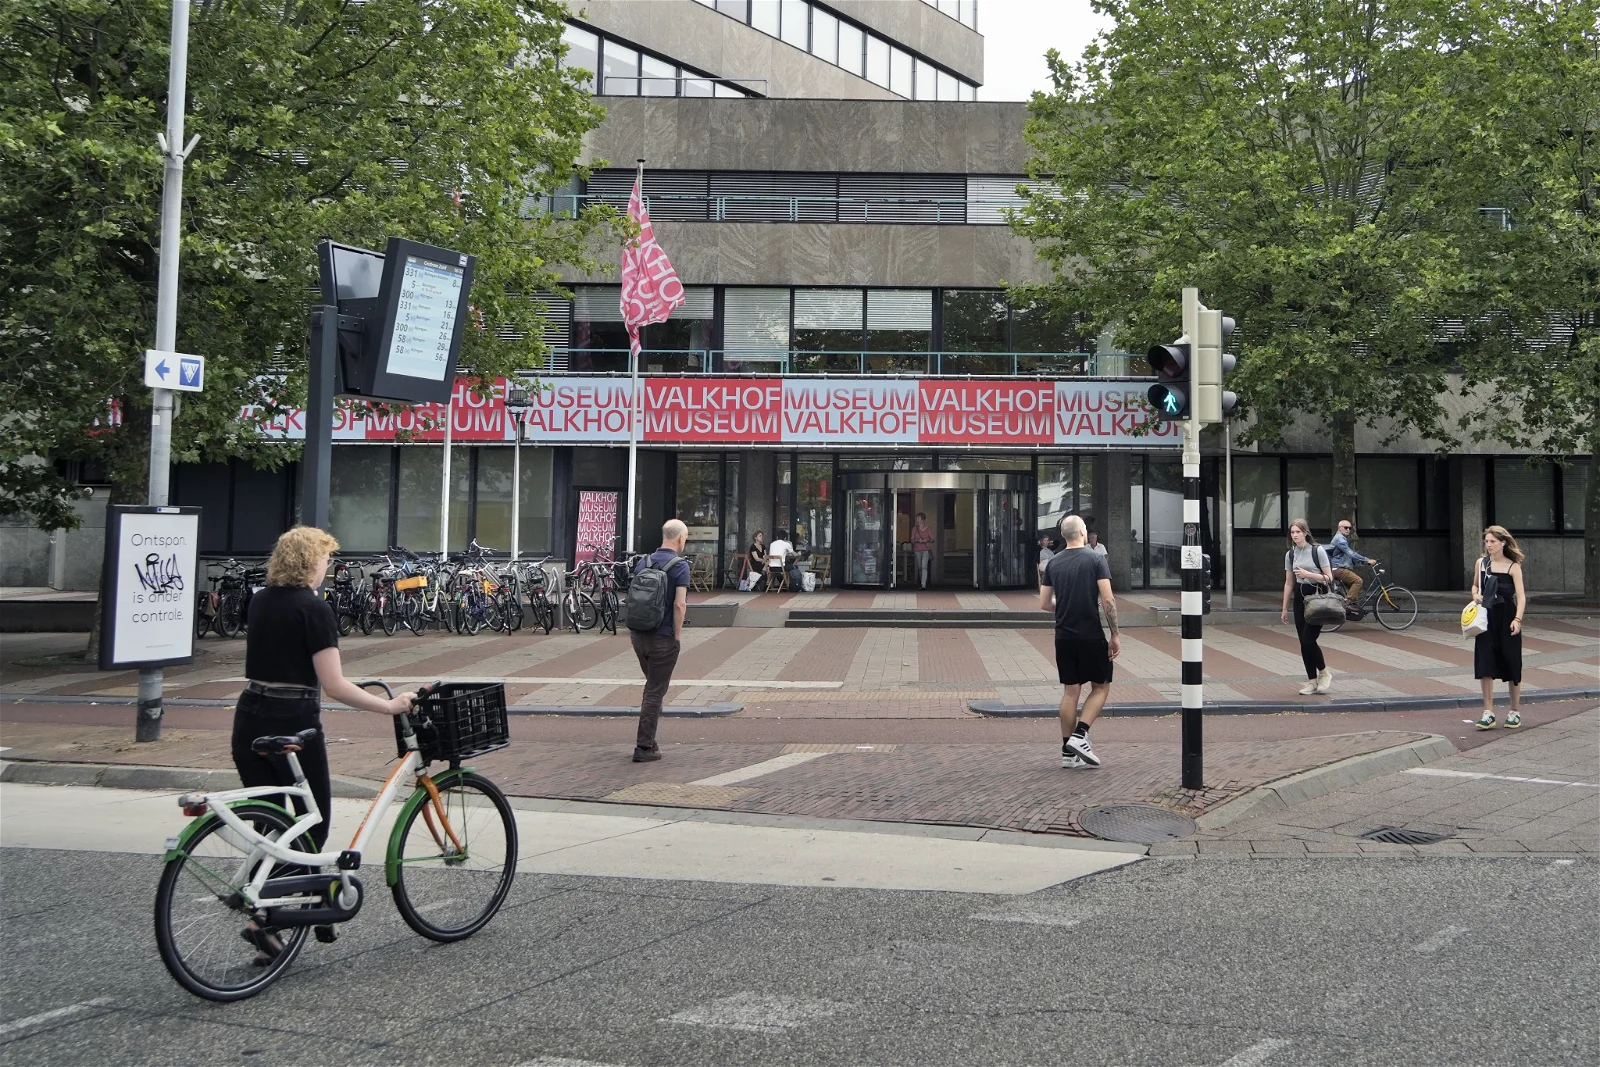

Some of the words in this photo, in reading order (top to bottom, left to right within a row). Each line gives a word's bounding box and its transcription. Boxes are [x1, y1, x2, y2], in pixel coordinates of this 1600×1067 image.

[406, 268, 418, 277] 331
[402, 290, 414, 299] 300
[400, 301, 411, 310] 331
[405, 313, 410, 321] 5
[444, 311, 451, 319] 16
[396, 323, 408, 332] 300
[441, 321, 448, 329] 21
[398, 334, 406, 343] 58
[439, 332, 447, 340] 26
[396, 345, 404, 353] 58
[437, 343, 445, 351] 29
[435, 353, 443, 361] 56
[646, 386, 781, 410] VALKHOF
[784, 387, 915, 411] MUSEUM
[920, 388, 1053, 412] VALKHOF
[1056, 390, 1151, 413] MUSE
[645, 410, 778, 434] MUSEUM
[784, 411, 917, 435] VALKHOF
[920, 412, 1051, 436] MUSEUM
[580, 492, 618, 502] VALKHOF
[579, 502, 617, 512] MUSEUM
[579, 512, 617, 522] VALKHOF
[577, 522, 616, 532] MUSEUM
[131, 533, 187, 549] Ontspan.
[132, 591, 144, 604] is
[148, 590, 182, 603] onder
[132, 608, 184, 623] controle.
